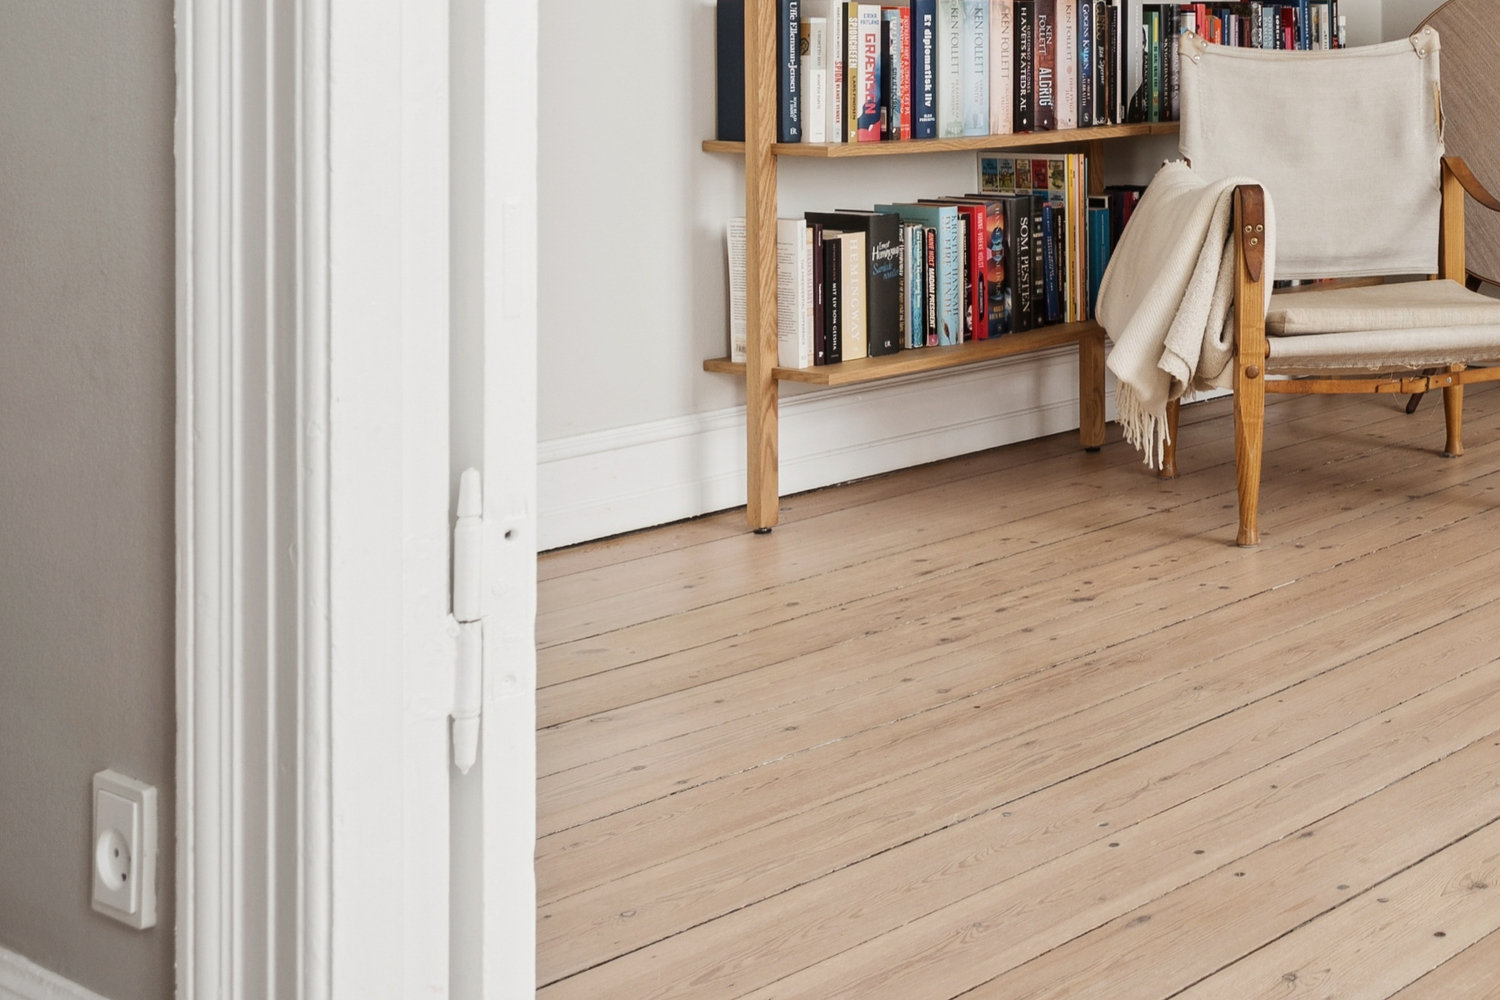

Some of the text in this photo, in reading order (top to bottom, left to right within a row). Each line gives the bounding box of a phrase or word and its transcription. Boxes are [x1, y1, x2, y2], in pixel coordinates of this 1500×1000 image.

[788, 2, 798, 92] Uffe Ellemann-Jensen
[849, 17, 857, 68] SPIONCHEFEN
[923, 14, 933, 107] Et diplomatisk liv
[950, 7, 960, 76] KEN FOLLETT
[974, 7, 984, 75] KEN FOLLETT
[1001, 12, 1009, 80] KEN FOLLETT
[1038, 14, 1046, 56] FOLLETT
[1082, 4, 1090, 70] GØGENS KALDEN
[835, 61, 843, 83] SPION
[864, 33, 876, 114] GRÆNSEN
[1038, 67, 1052, 107] ALDRIG
[850, 239, 860, 341] HEMINGWAY
[1020, 217, 1030, 312] SOM PESTEN
